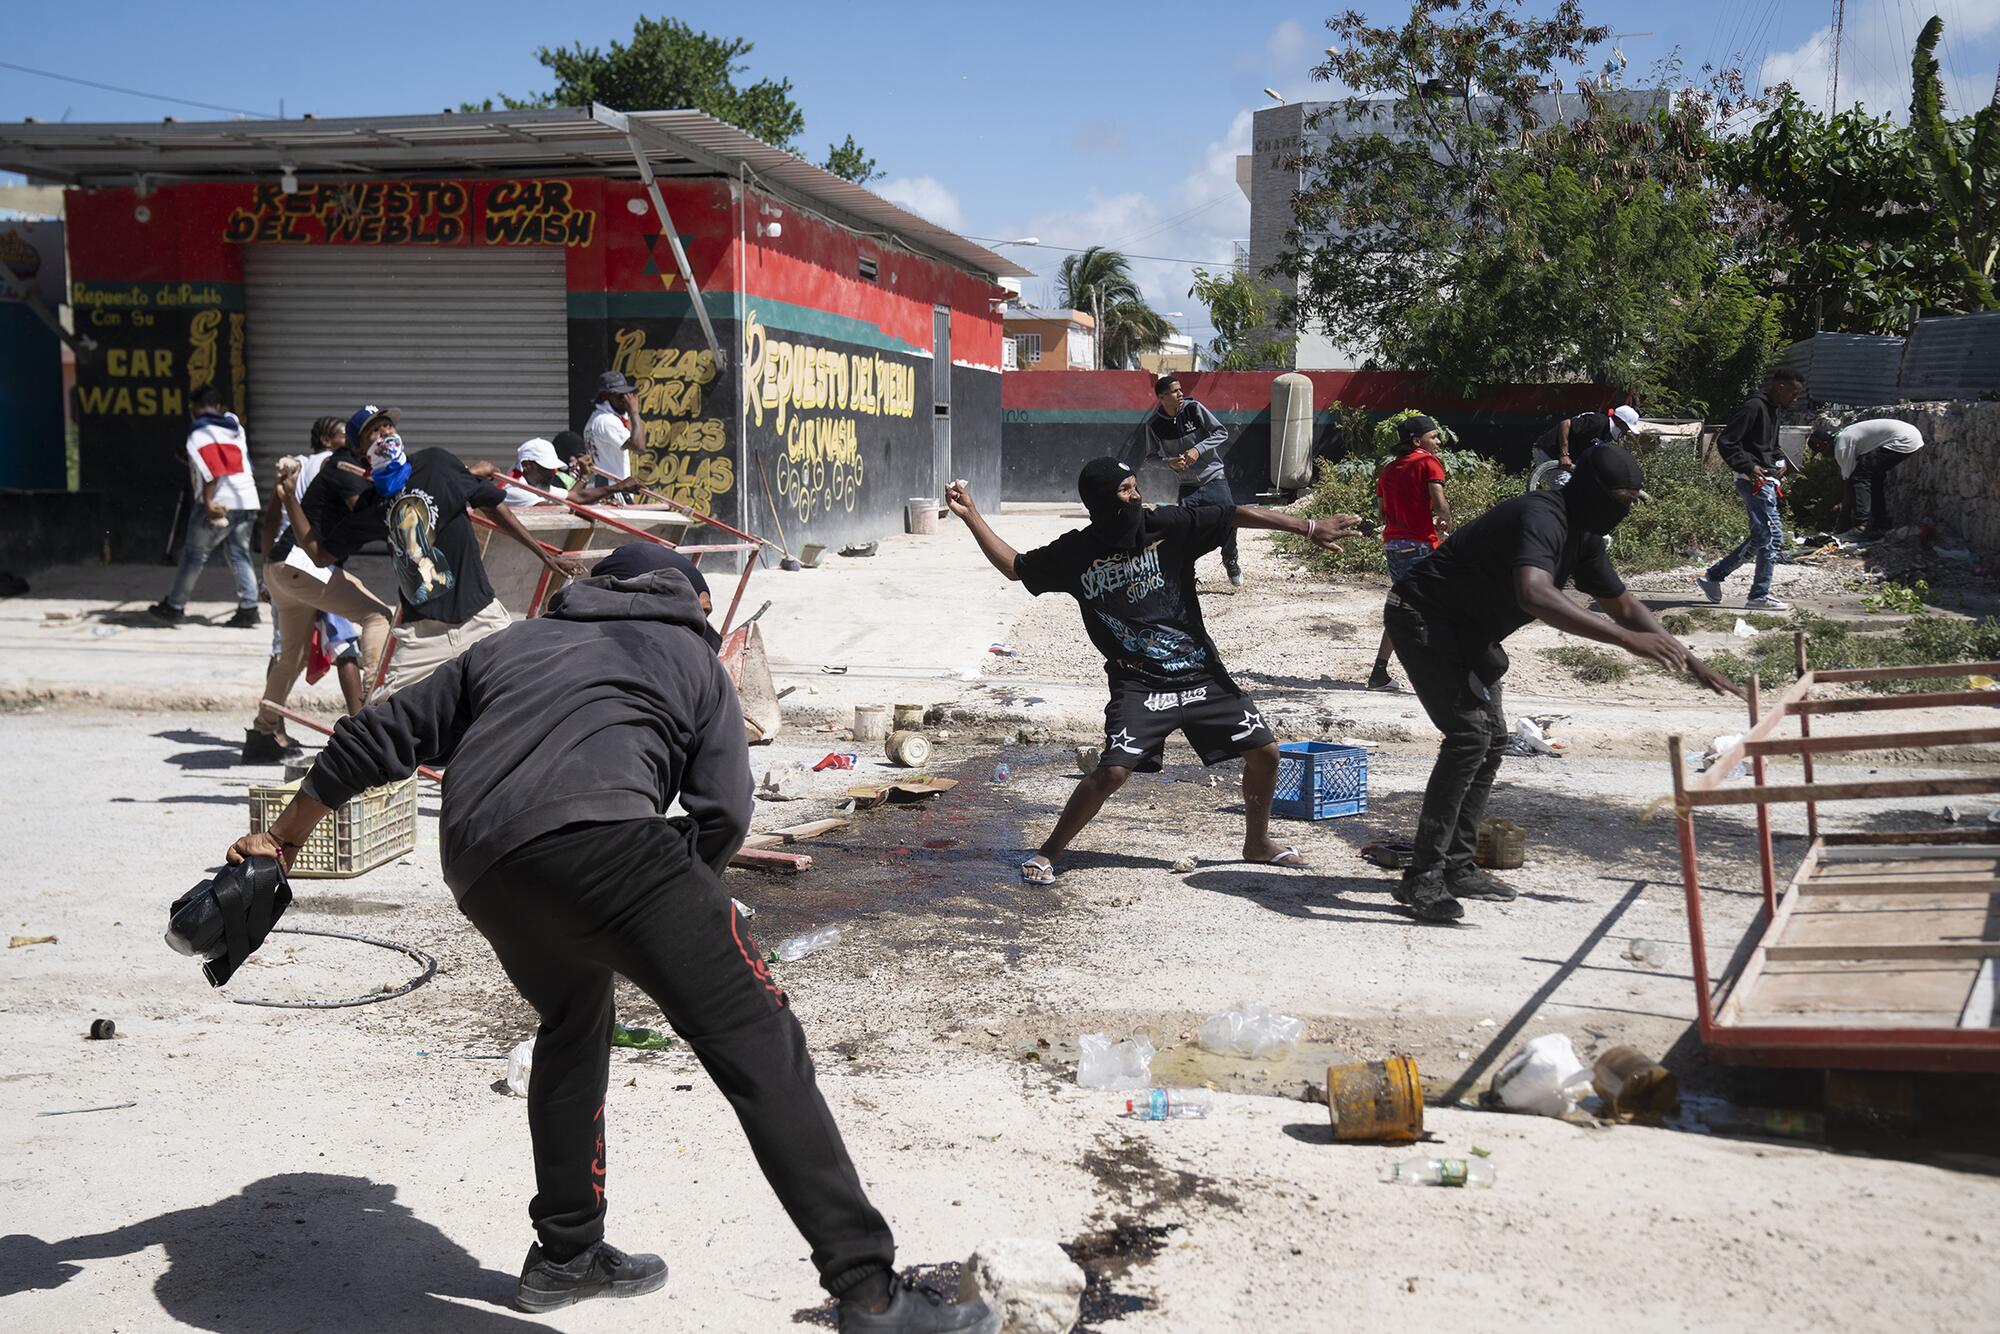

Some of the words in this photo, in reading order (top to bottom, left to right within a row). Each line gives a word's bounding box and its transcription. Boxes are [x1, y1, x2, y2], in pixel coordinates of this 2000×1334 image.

[486, 180, 574, 216] CAR
[223, 207, 310, 244] DEL
[323, 212, 463, 243] PUEBLO
[486, 209, 597, 247] WASH
[91, 309, 120, 326] Con
[131, 309, 155, 326] Su
[107, 349, 173, 378] CAR
[744, 309, 849, 436] REPUESTO
[850, 355, 876, 415] DEL
[78, 386, 183, 416] WASH
[634, 376, 702, 418] PARA
[1126, 572, 1166, 604] STUDIOS
